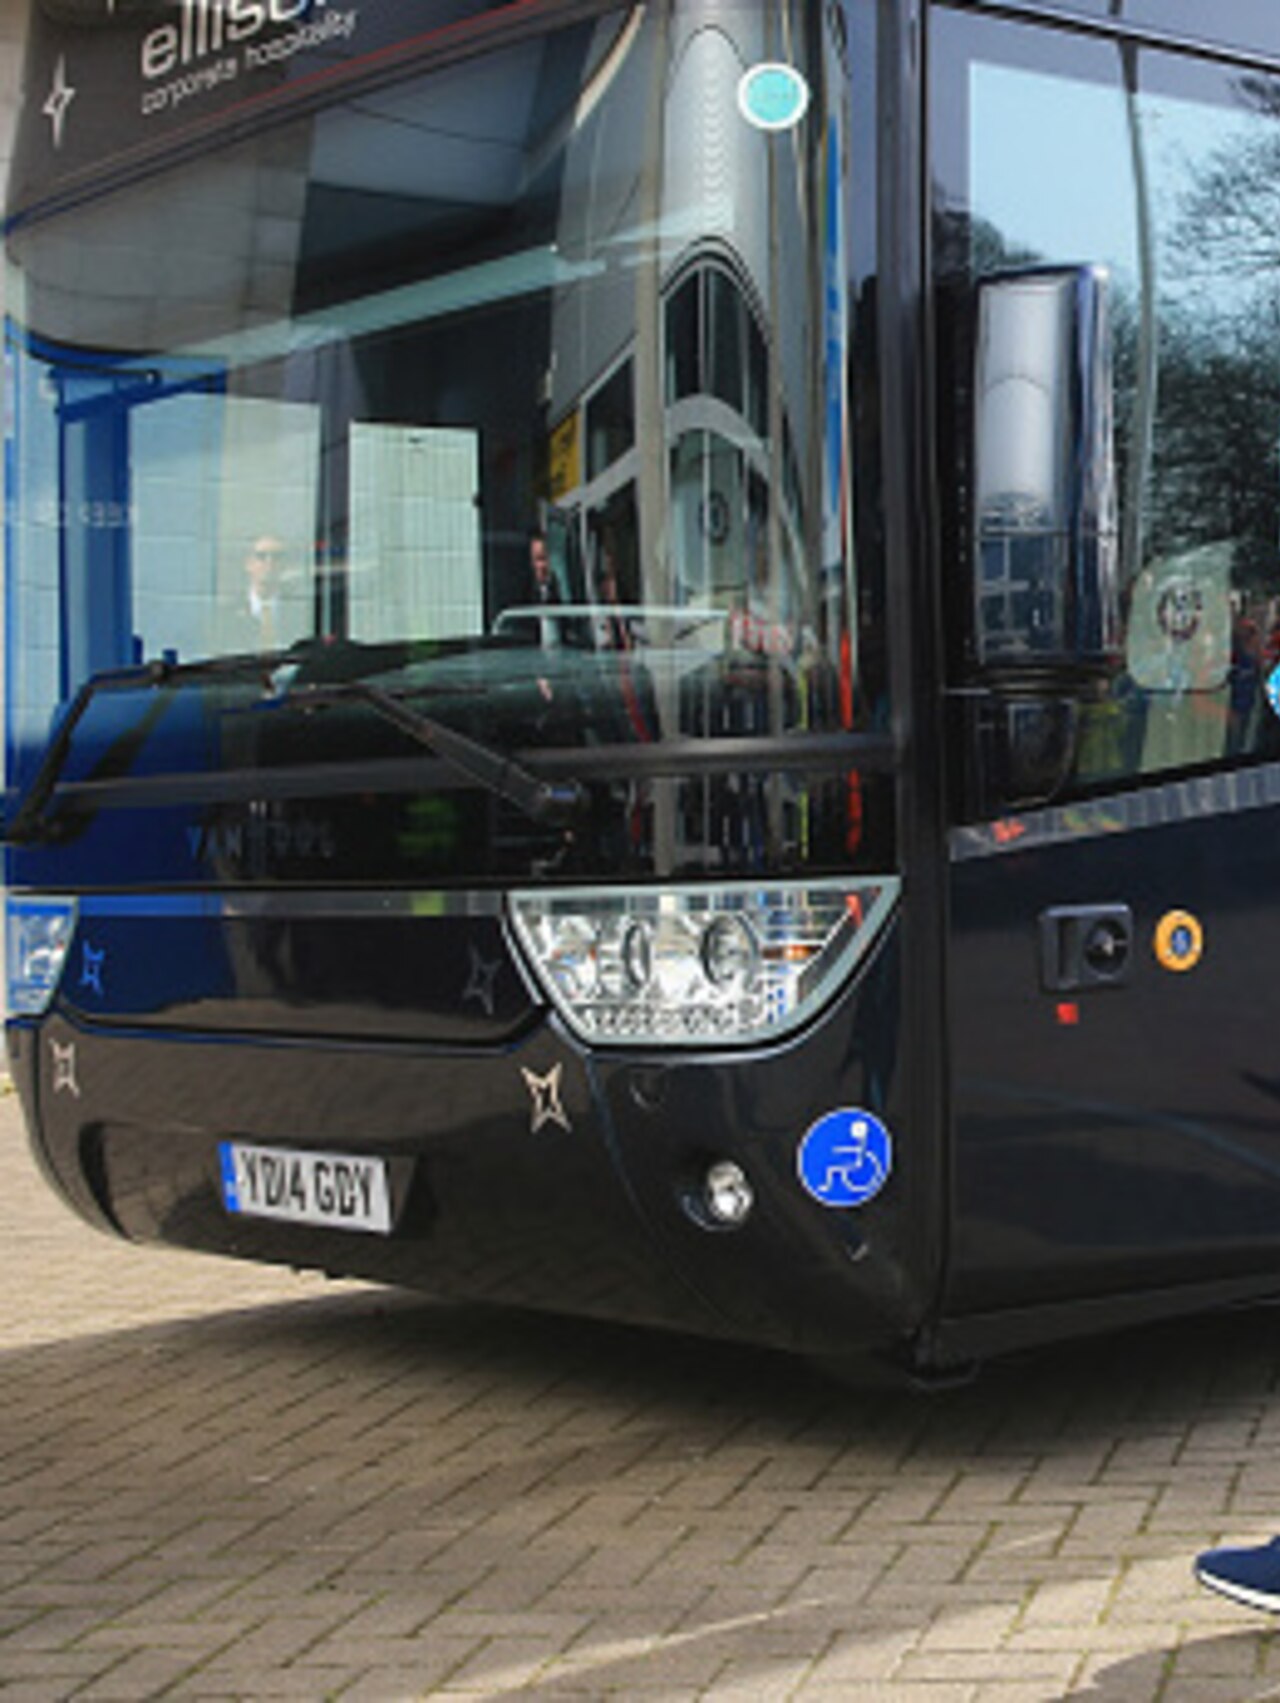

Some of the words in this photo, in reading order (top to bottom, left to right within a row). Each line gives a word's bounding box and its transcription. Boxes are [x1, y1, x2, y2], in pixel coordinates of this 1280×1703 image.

[141, 57, 238, 115] corporate
[245, 9, 357, 69] hospitality
[240, 1150, 306, 1213] YD14
[313, 1160, 373, 1218] GDY
